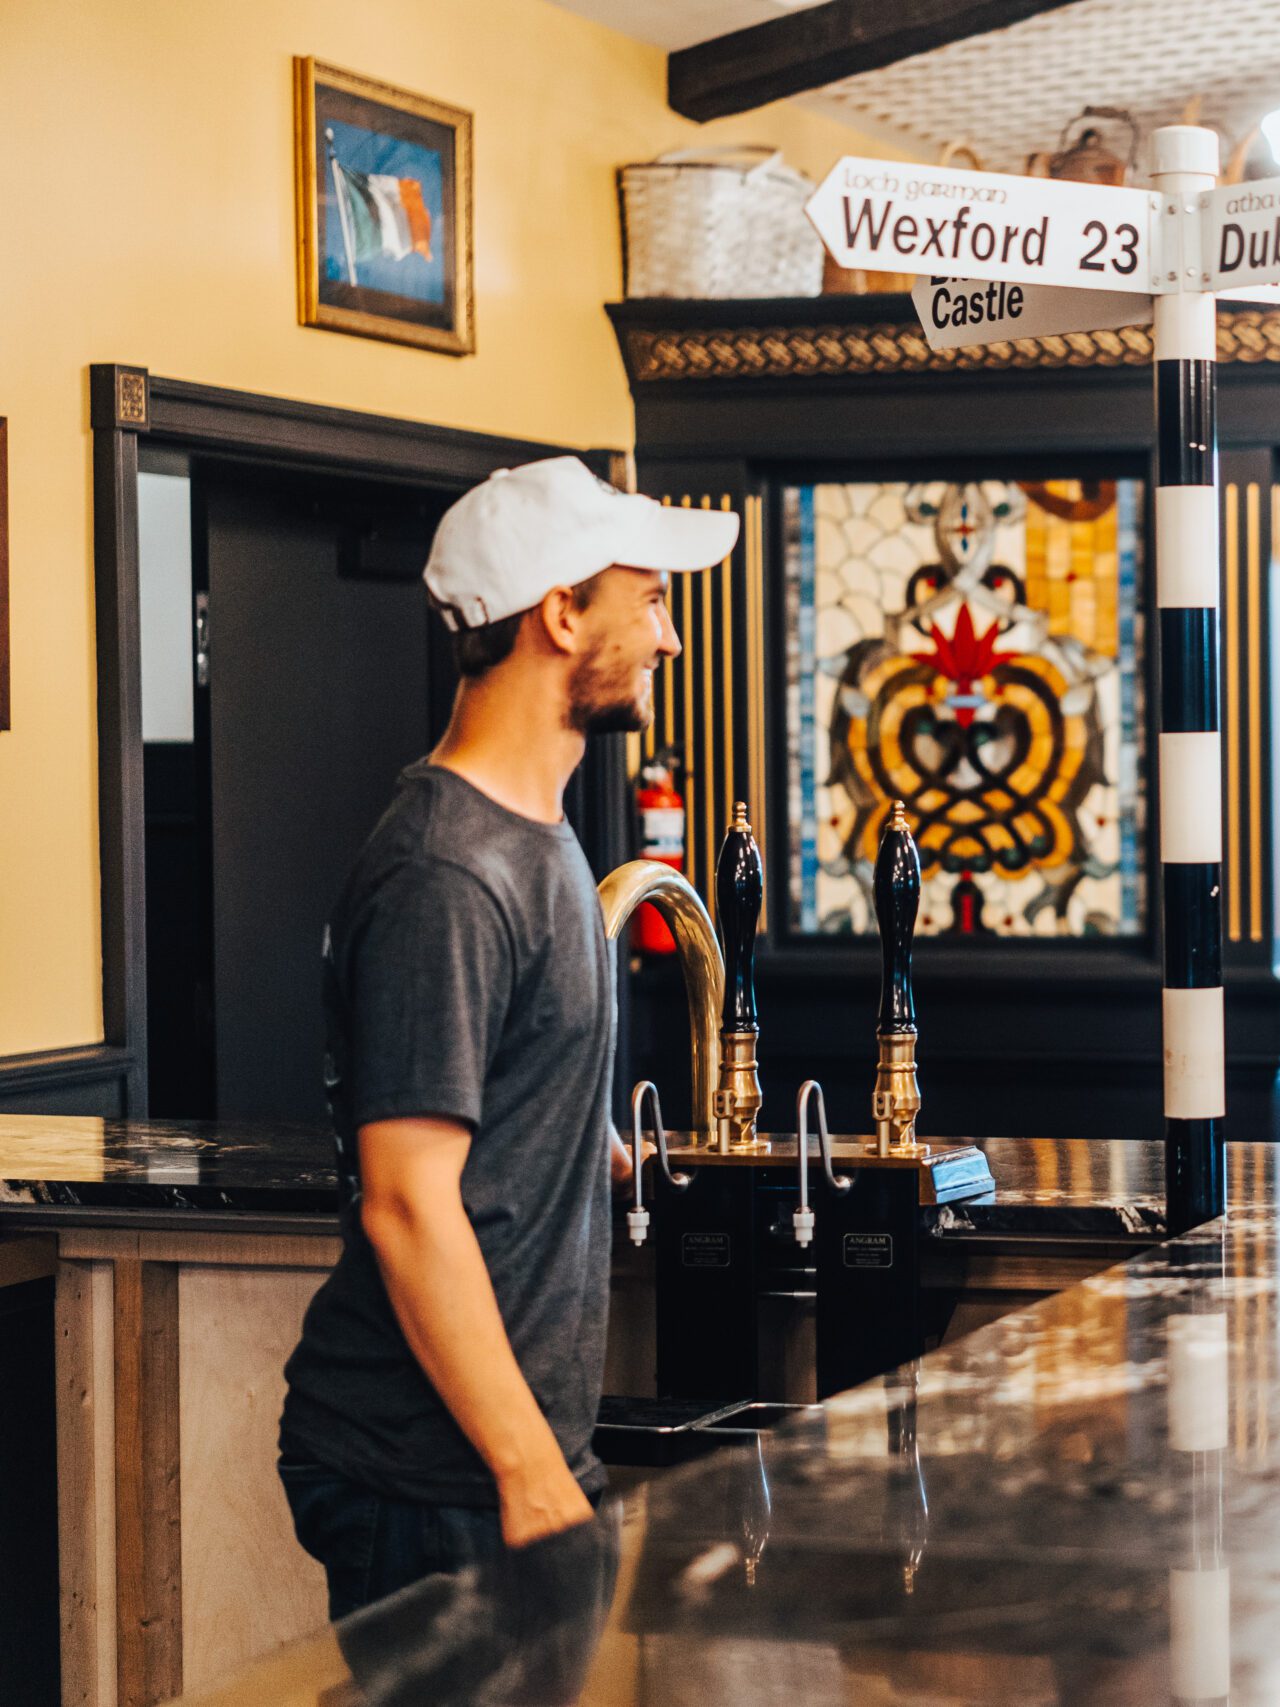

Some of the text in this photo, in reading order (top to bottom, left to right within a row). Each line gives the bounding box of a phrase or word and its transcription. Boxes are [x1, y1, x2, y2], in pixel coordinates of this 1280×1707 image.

[842, 196, 1140, 274] Wexford 23
[932, 281, 1024, 329] Castle
